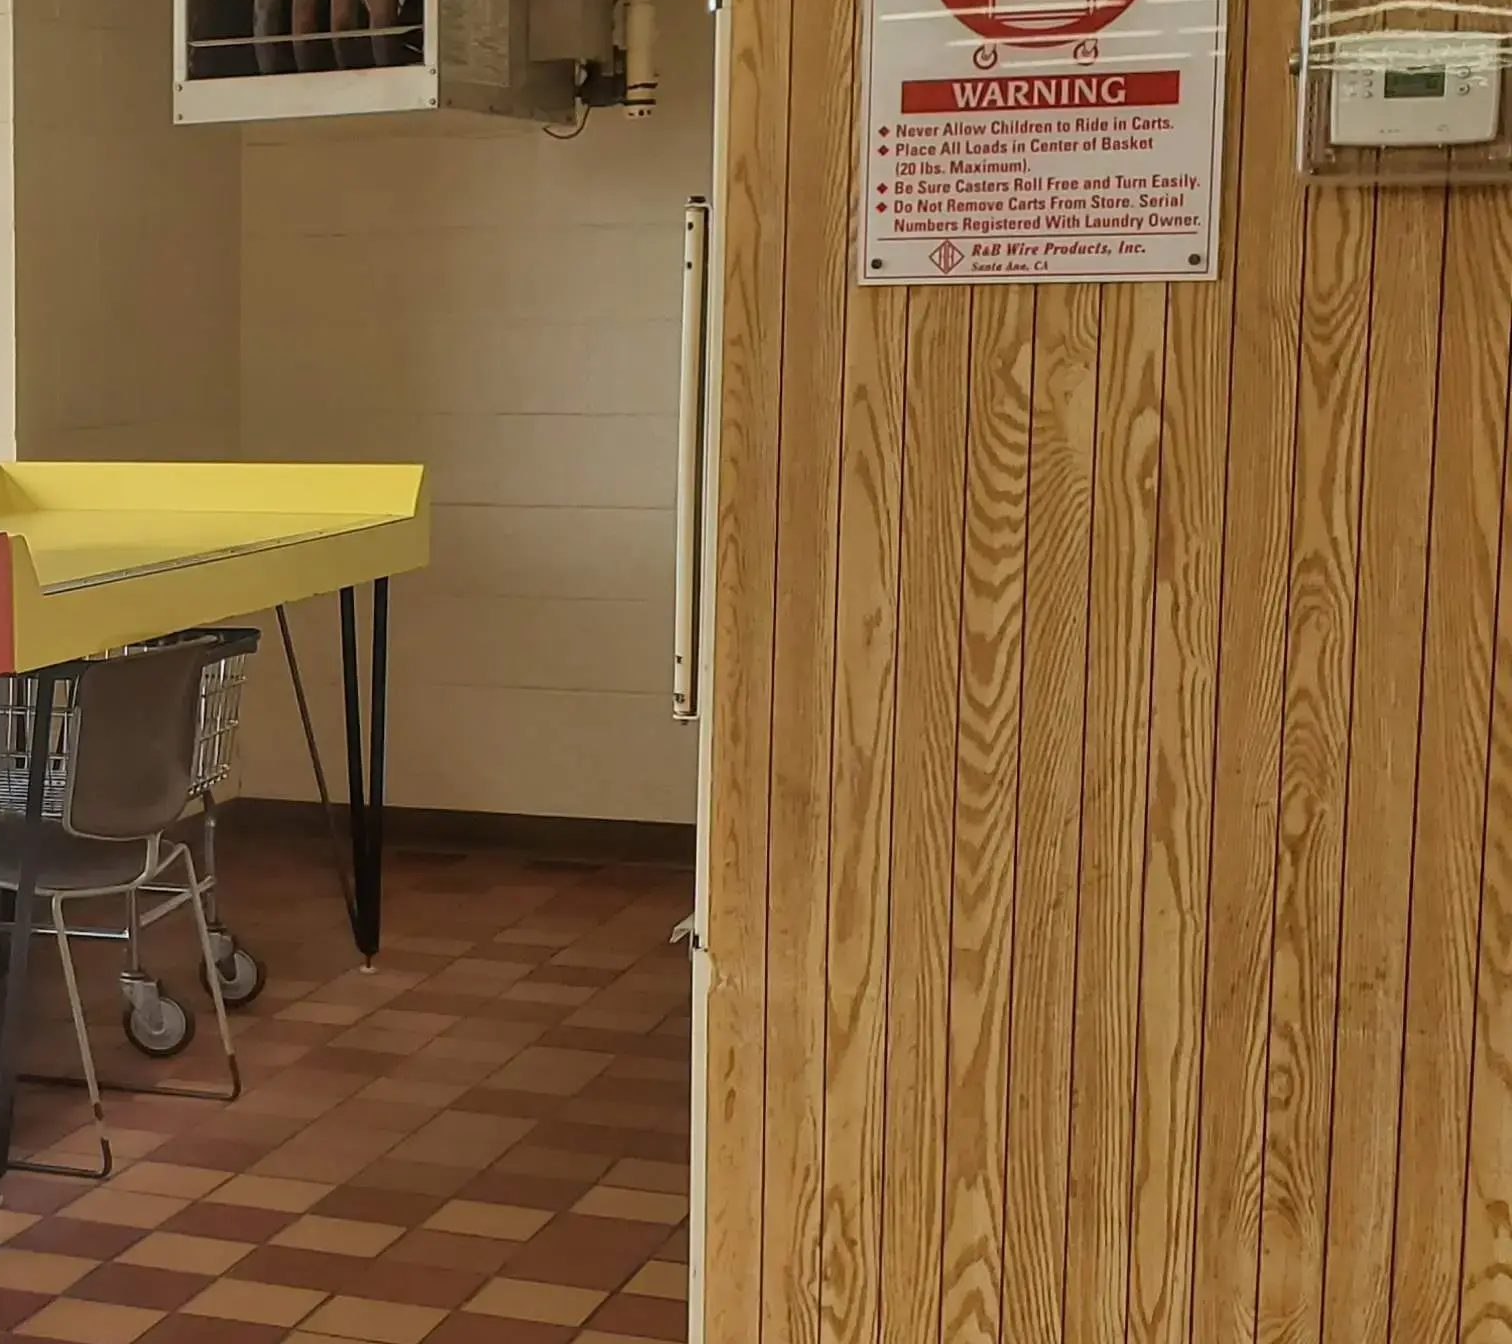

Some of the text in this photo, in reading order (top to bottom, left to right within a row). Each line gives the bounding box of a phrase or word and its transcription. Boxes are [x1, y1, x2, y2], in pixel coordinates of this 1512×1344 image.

[952, 77, 1126, 109] WARNING
[896, 116, 1174, 138] Never Allow Children to Ride in Carts.
[896, 136, 1153, 156] Place All Loads in Center of Basket
[895, 158, 1031, 177] (20 lbs. Maximum).
[894, 174, 1201, 194] Be Sure Casters Roll Free and Turn Easily.
[894, 193, 1184, 213] Do Not Remove Carts From Store. Serial
[894, 213, 1201, 233] Numbers Registered With Laundry Owner.
[971, 241, 1146, 257] R&B Wire Products, Inc.
